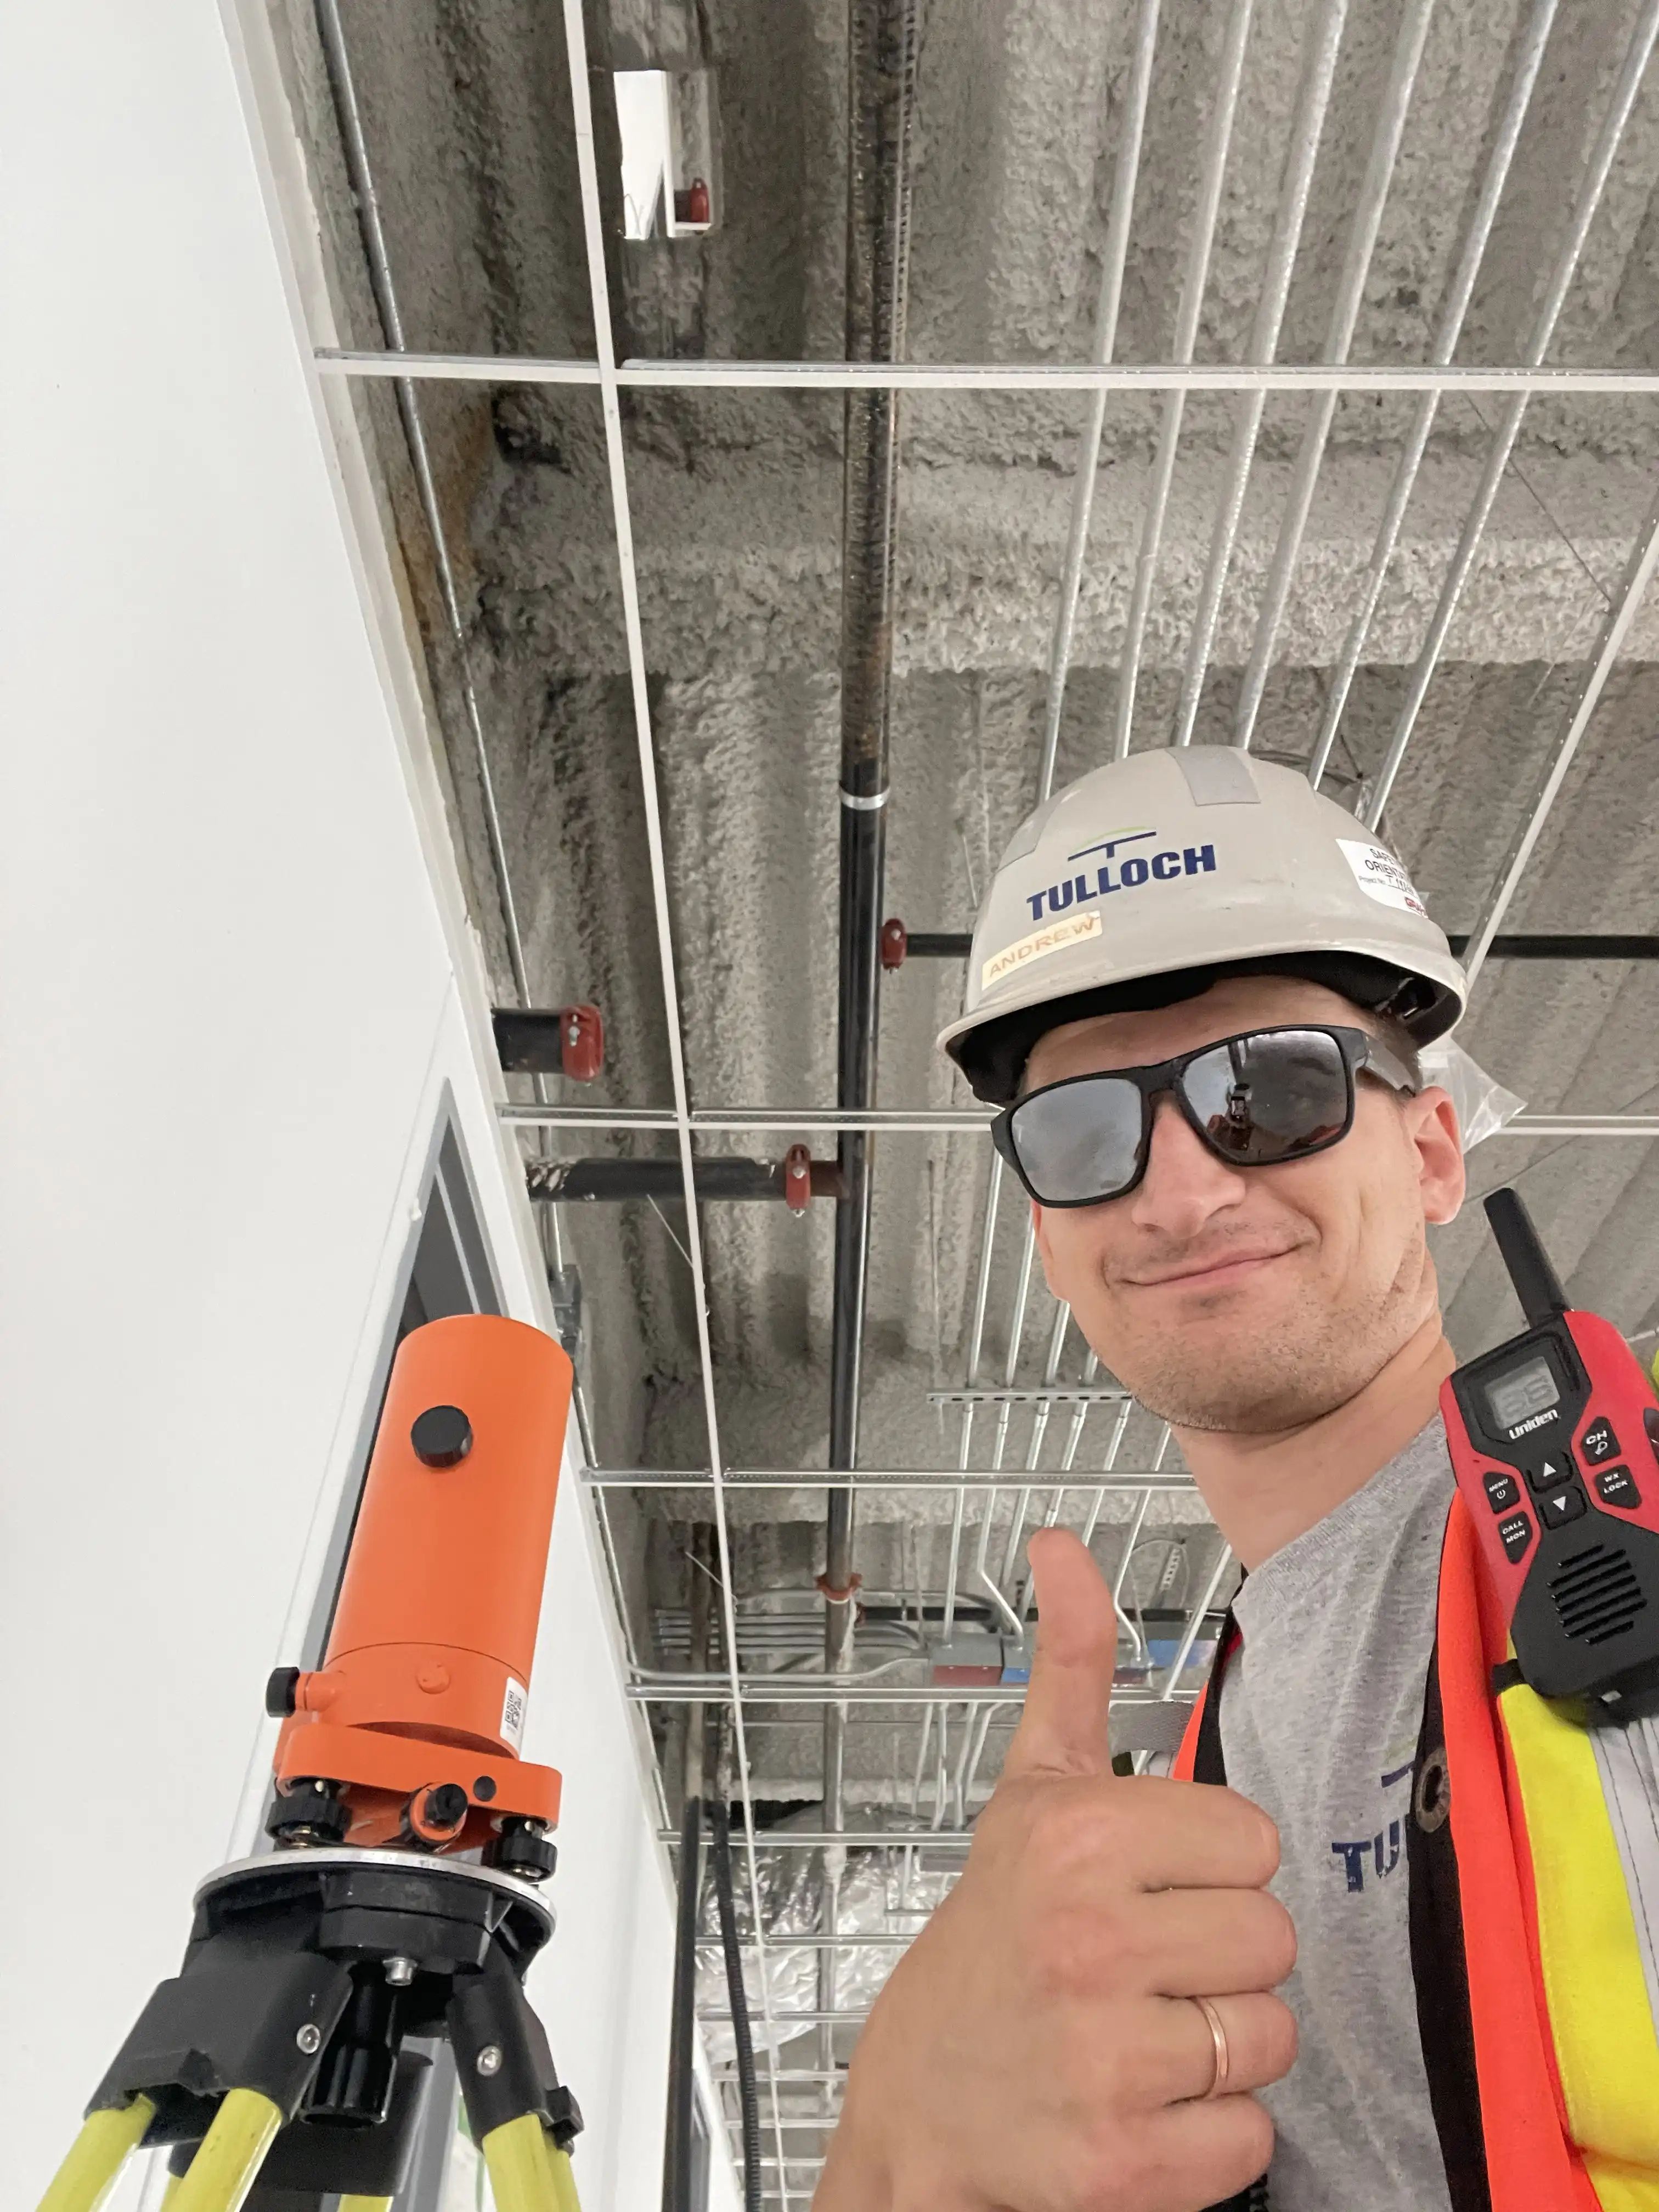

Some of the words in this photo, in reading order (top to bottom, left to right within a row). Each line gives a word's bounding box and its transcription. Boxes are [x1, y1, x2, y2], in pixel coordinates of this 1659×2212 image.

[1026, 844, 1216, 921] TULLOCH
[989, 916, 1096, 977] ANDREW
[1586, 1430, 1608, 1445] CH
[1604, 1480, 1628, 1494] LOCK
[1502, 1520, 1524, 1535] CALL
